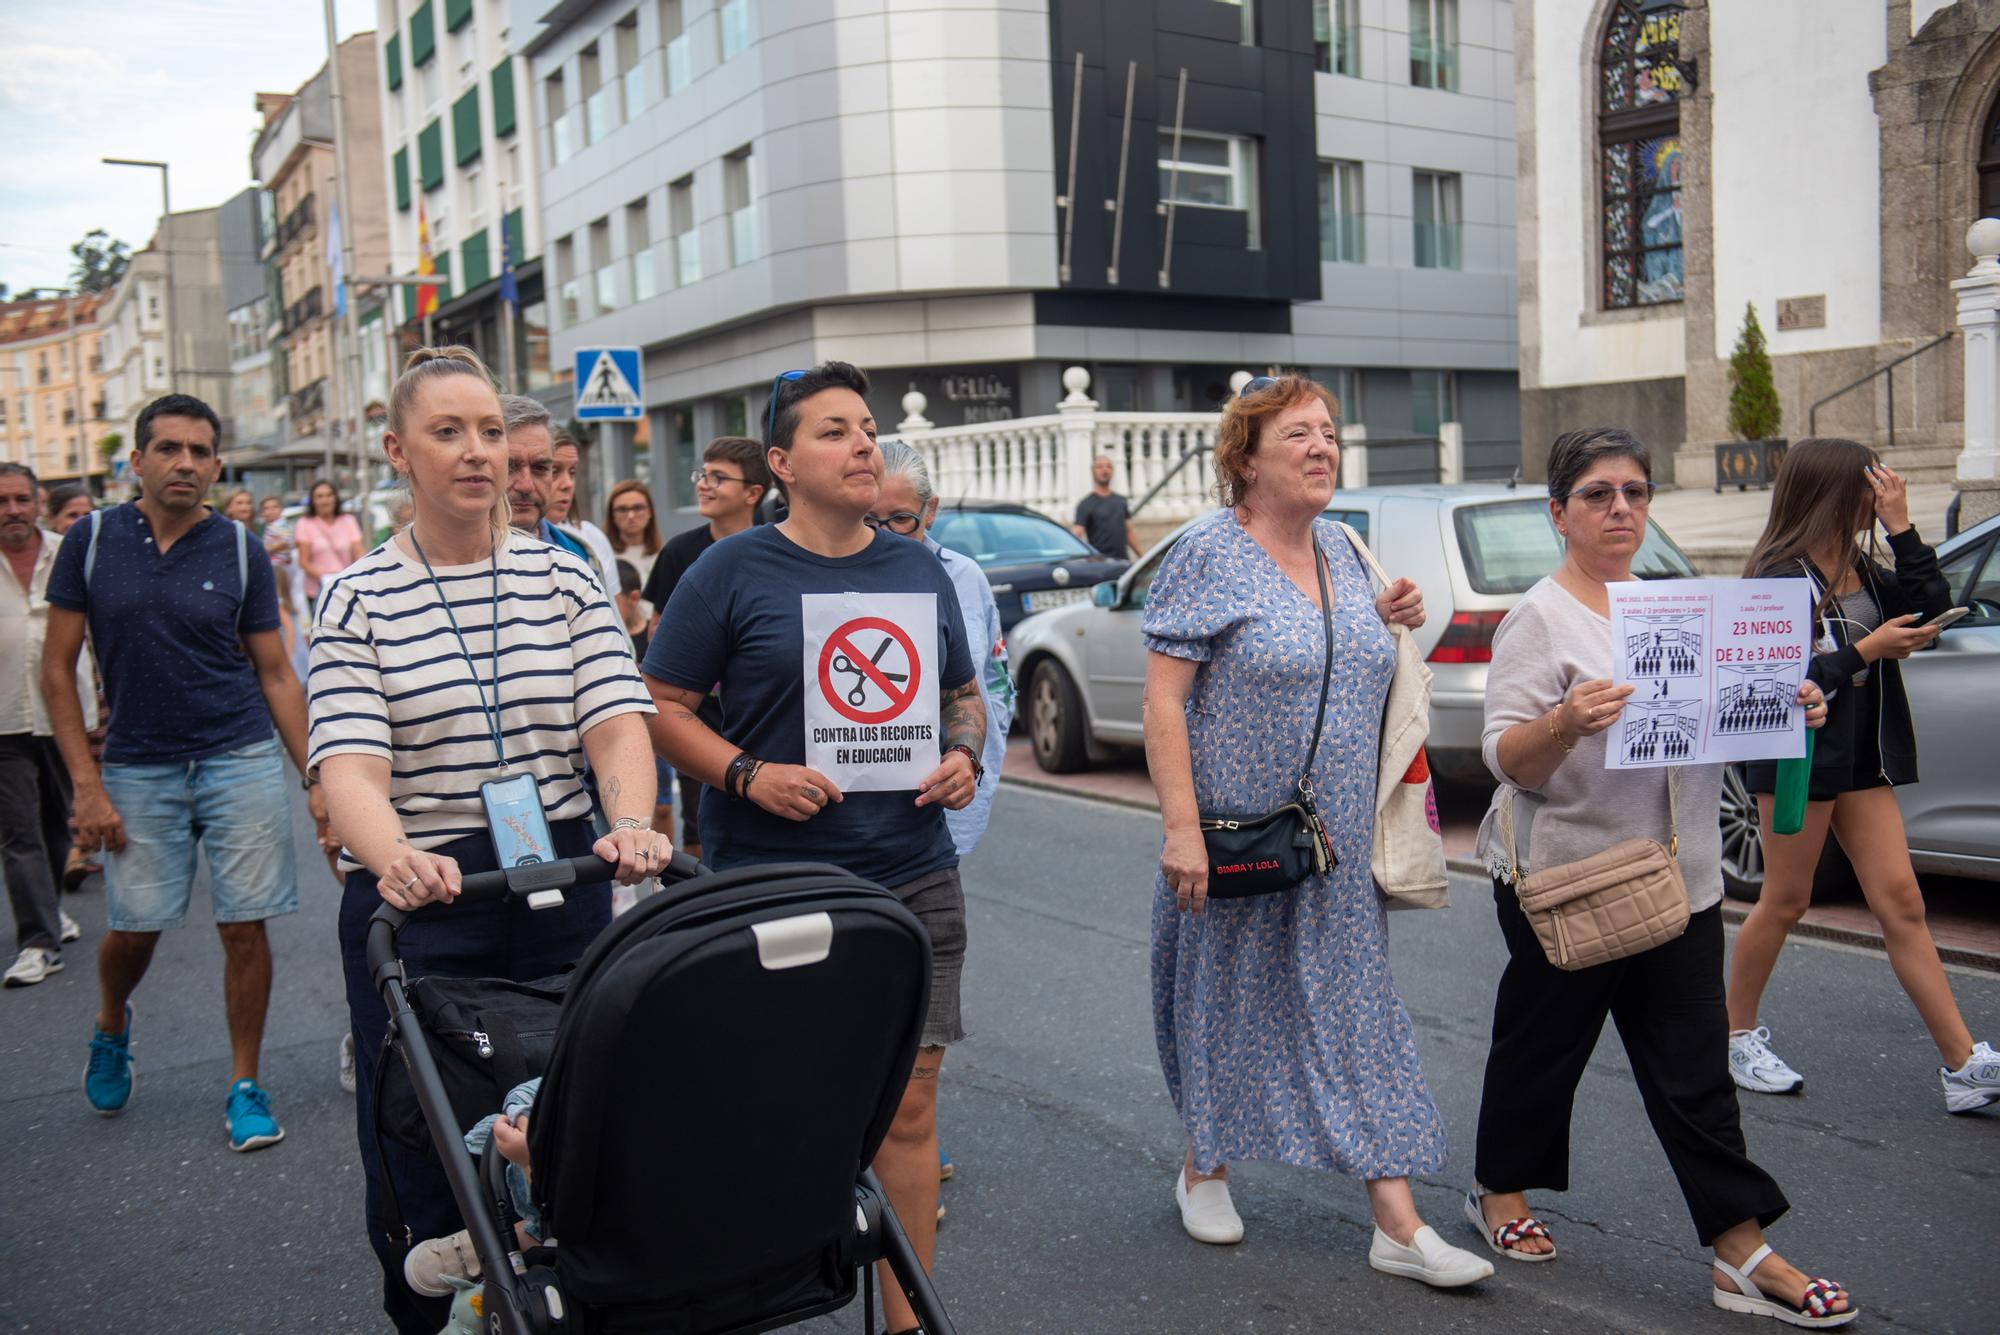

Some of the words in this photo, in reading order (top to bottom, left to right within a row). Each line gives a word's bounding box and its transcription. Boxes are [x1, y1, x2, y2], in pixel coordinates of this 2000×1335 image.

[1653, 607, 1681, 615] profesores
[1763, 604, 1784, 612] profesor
[1733, 621, 1747, 635] 23
[1751, 620, 1792, 635] NENOS
[1716, 648, 1733, 661] DE
[1736, 648, 1743, 661] 2
[1747, 650, 1754, 661] e
[1758, 647, 1764, 660] 3
[1767, 645, 1801, 660] ANOS
[813, 727, 857, 744] CONTRA
[859, 726, 878, 742] LOS
[880, 724, 932, 741] RECORTES
[836, 749, 849, 764] EN
[852, 744, 911, 764] EDUCACIÓN
[1217, 863, 1247, 874] BIMBA
[1247, 862, 1254, 871] Y
[1255, 860, 1279, 870] LOLA
